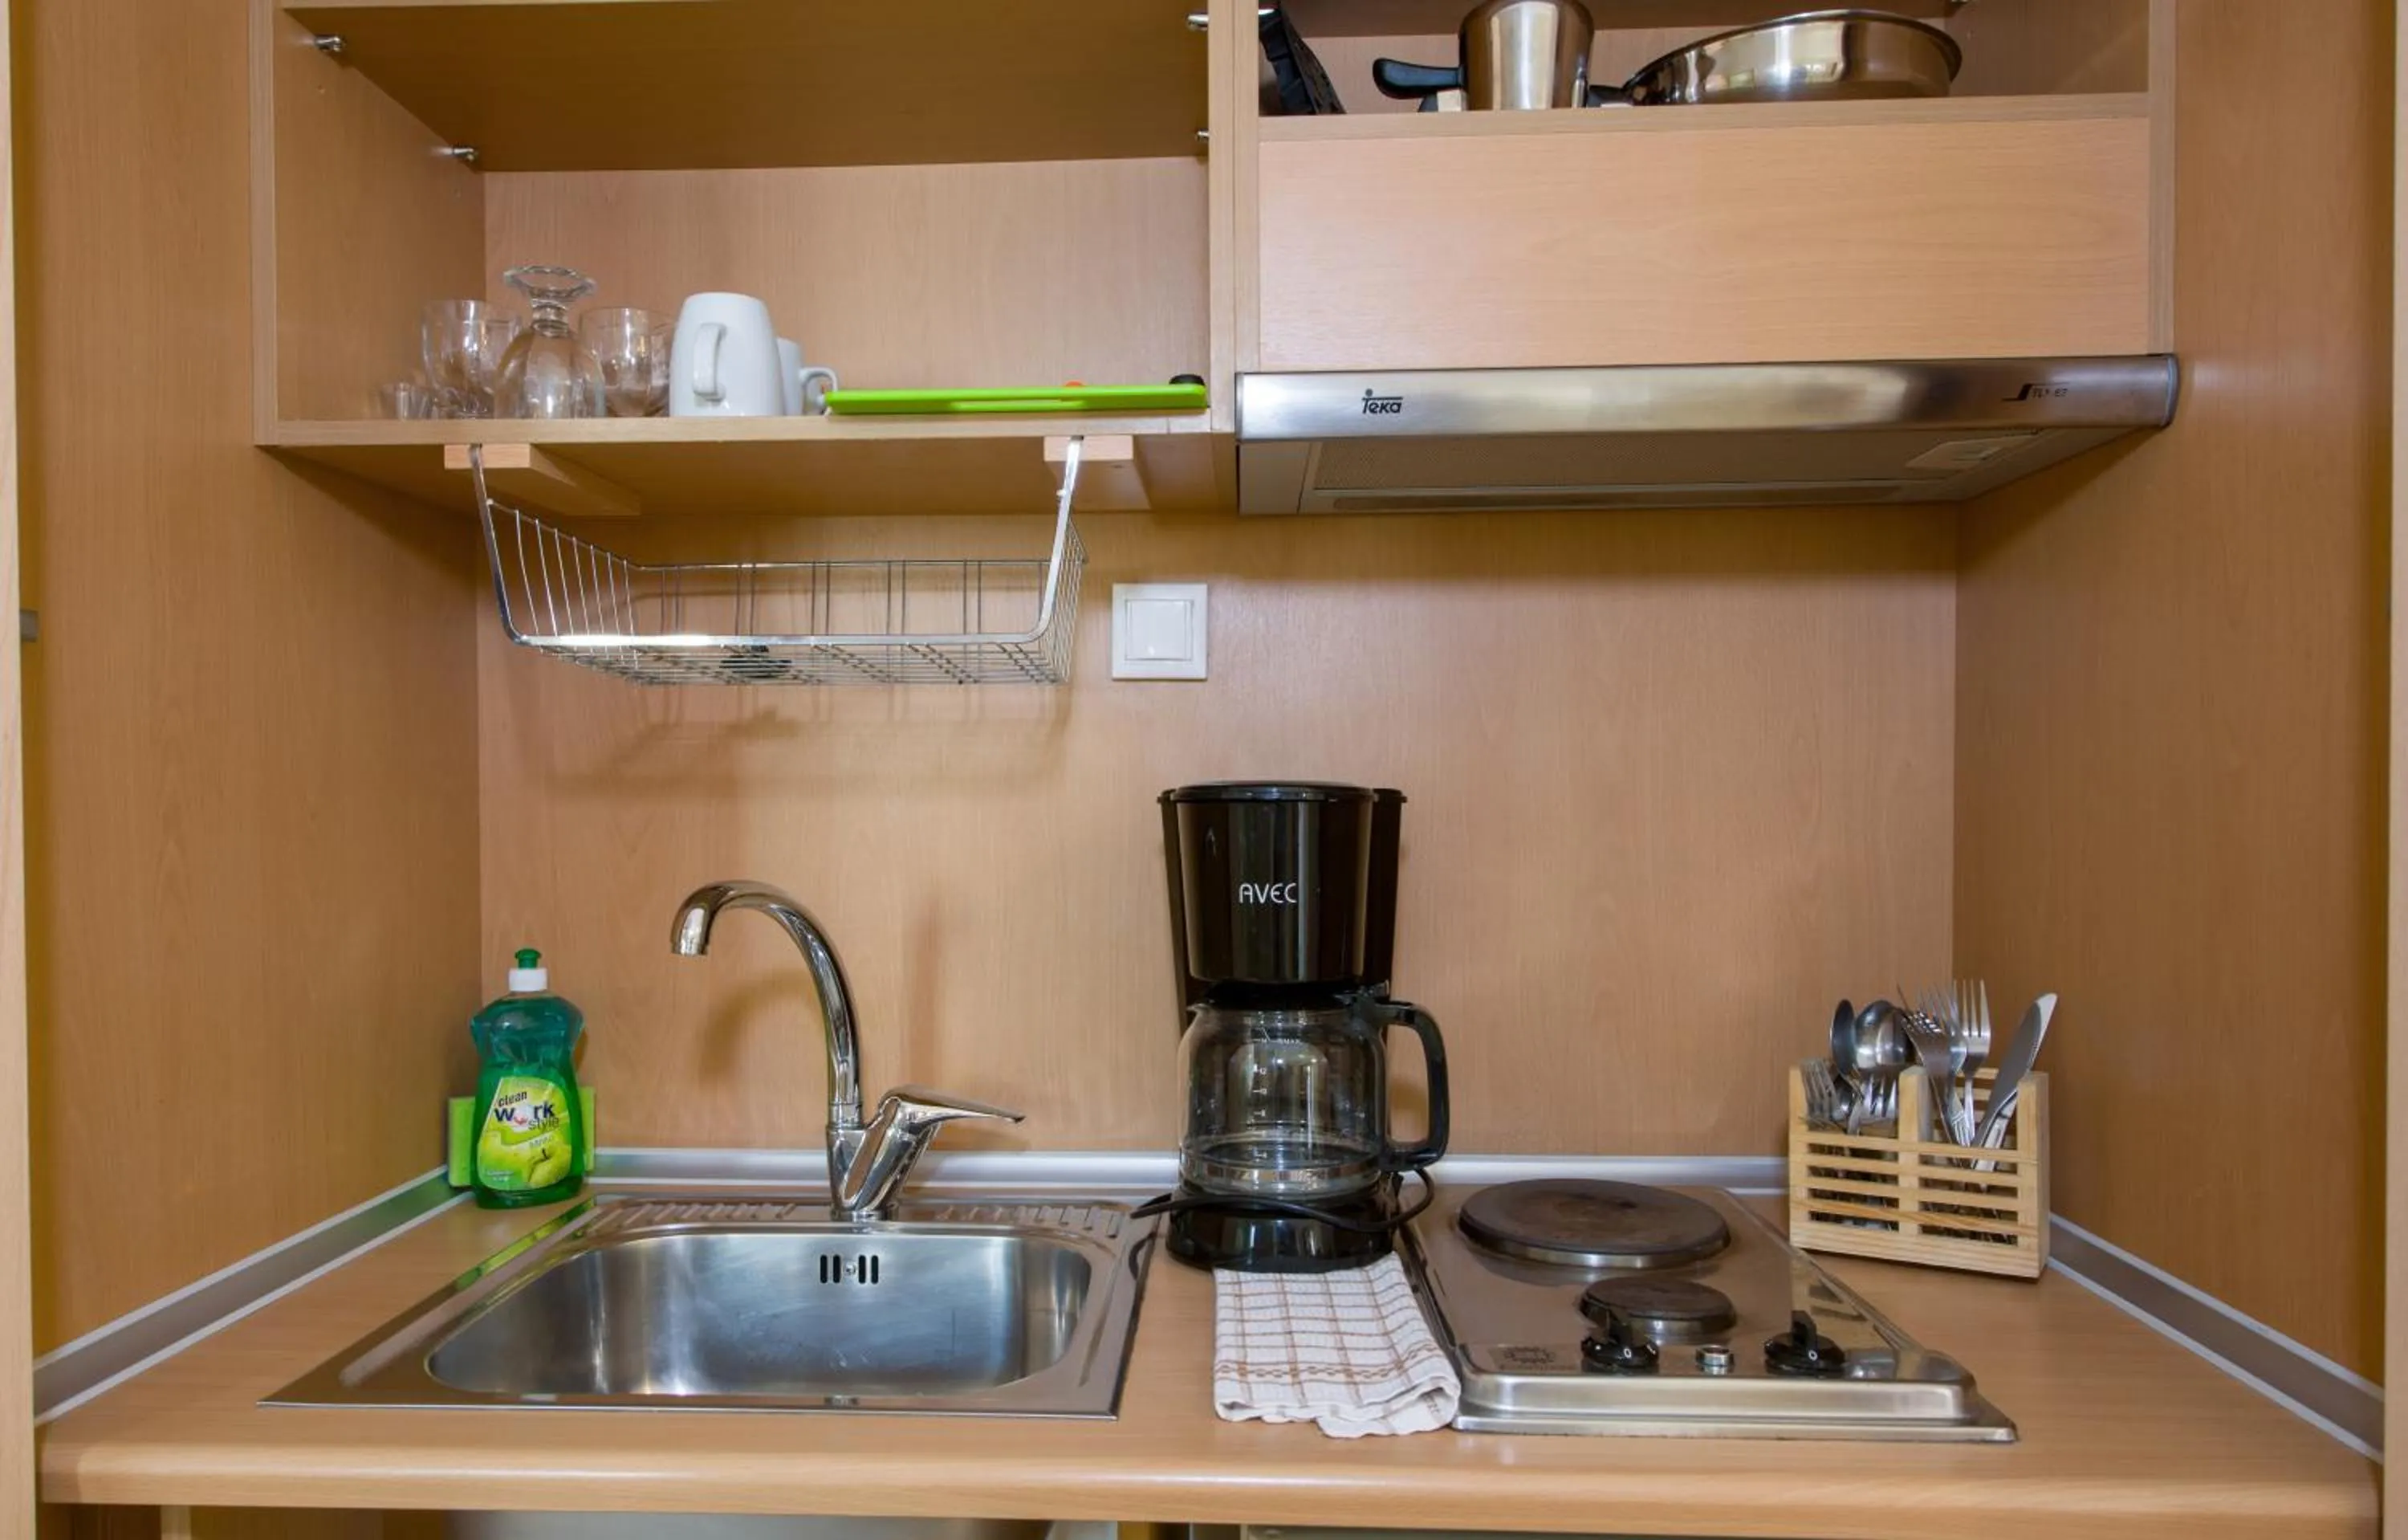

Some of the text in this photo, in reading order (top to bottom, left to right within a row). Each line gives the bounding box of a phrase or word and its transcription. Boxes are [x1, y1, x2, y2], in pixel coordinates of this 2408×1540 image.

[1239, 882, 1298, 904] AVEC
[498, 1090, 527, 1107] clean
[527, 1116, 559, 1131] style
